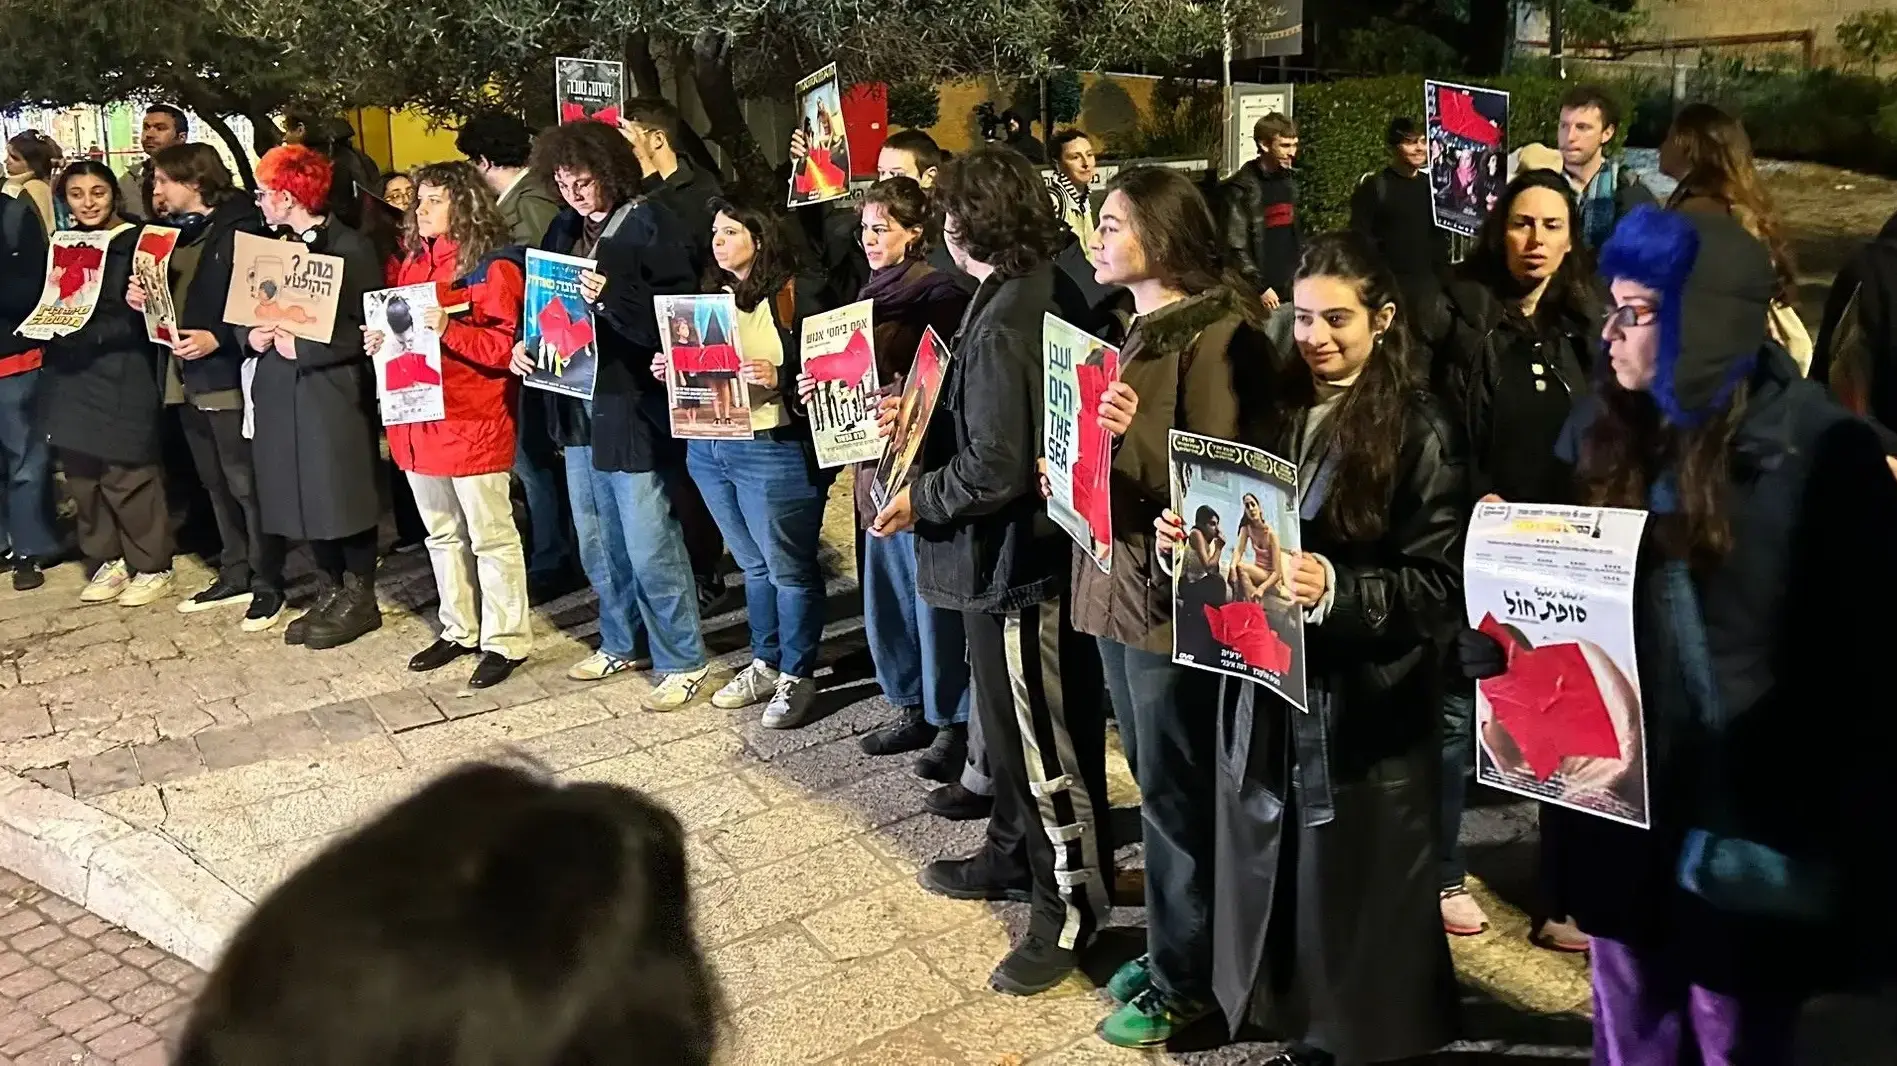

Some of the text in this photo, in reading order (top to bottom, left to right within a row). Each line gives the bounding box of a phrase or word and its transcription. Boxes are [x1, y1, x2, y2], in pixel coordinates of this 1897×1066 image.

[567, 79, 611, 98] מיתה טובה
[308, 260, 333, 279] מות
[826, 324, 847, 338] ביחסי
[850, 318, 867, 332] אפס
[806, 330, 824, 345] אנוש
[1049, 374, 1072, 416] הים
[1049, 408, 1072, 448] THE
[1048, 436, 1068, 475] SEA
[1540, 602, 1587, 623] סופת
